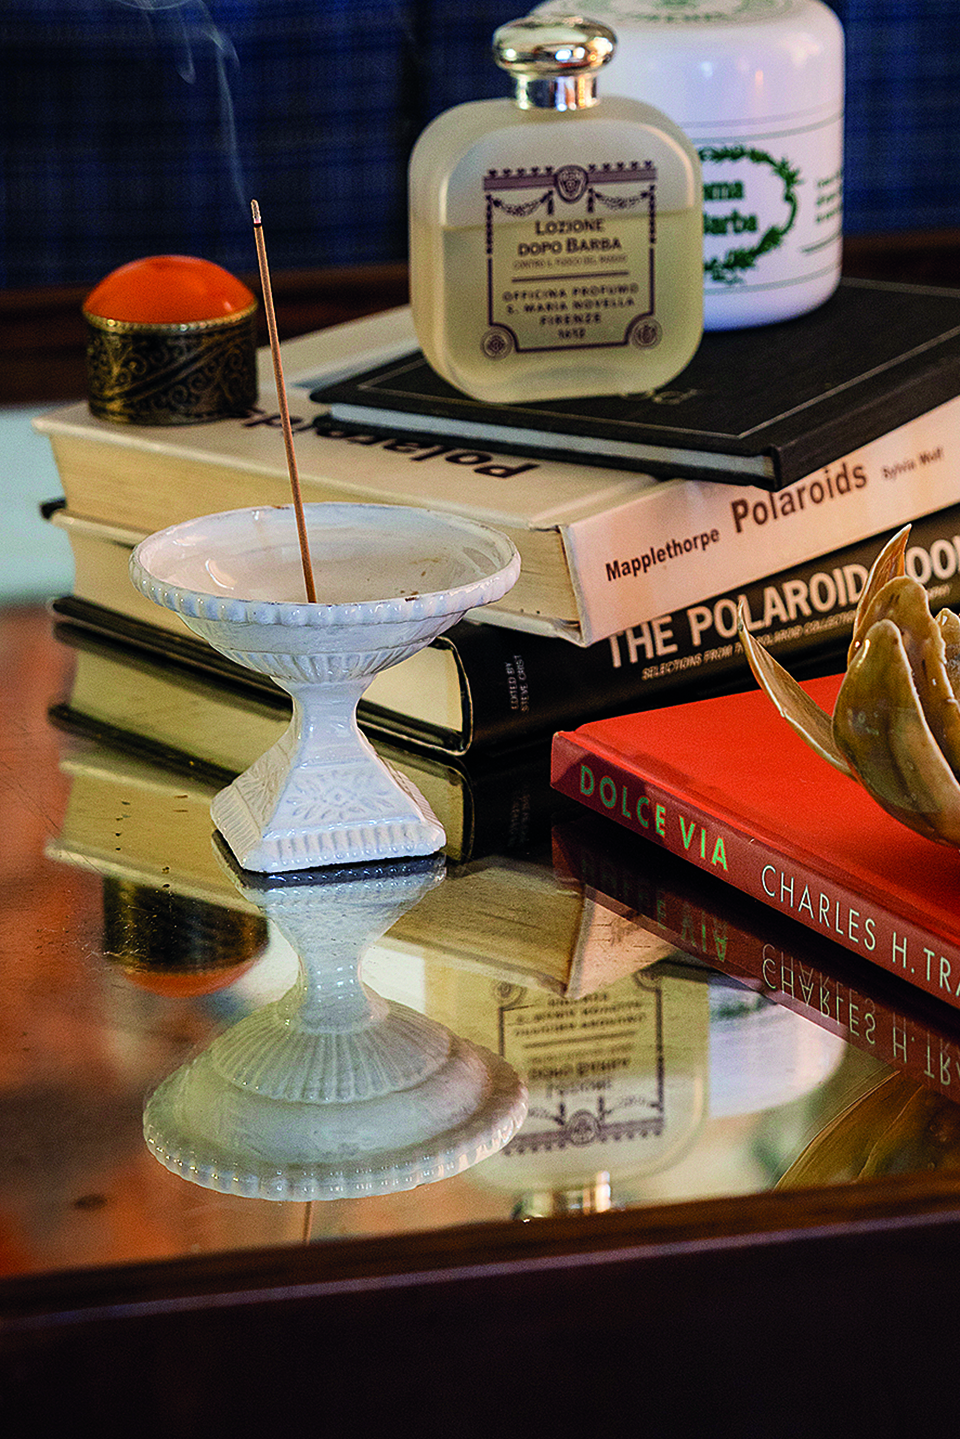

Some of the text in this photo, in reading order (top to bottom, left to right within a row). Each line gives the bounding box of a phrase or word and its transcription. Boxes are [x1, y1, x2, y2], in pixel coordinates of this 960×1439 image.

[535, 218, 604, 235] LOZIONE
[517, 237, 622, 257] DOPO BARBA
[501, 282, 640, 303] OFFICINA PROFUMO
[524, 300, 568, 313] MARIA
[572, 295, 635, 310] NOVELLA
[540, 313, 602, 326] FIRENZE
[605, 526, 721, 582] Mapplethorpe
[731, 462, 868, 534] Polaroids
[608, 615, 679, 669] THE
[688, 563, 871, 648] POLAROID
[641, 653, 702, 681] SELECTIONS
[579, 764, 667, 838] DOLCE
[679, 815, 729, 872] VIA
[761, 864, 877, 952] CHARLES
